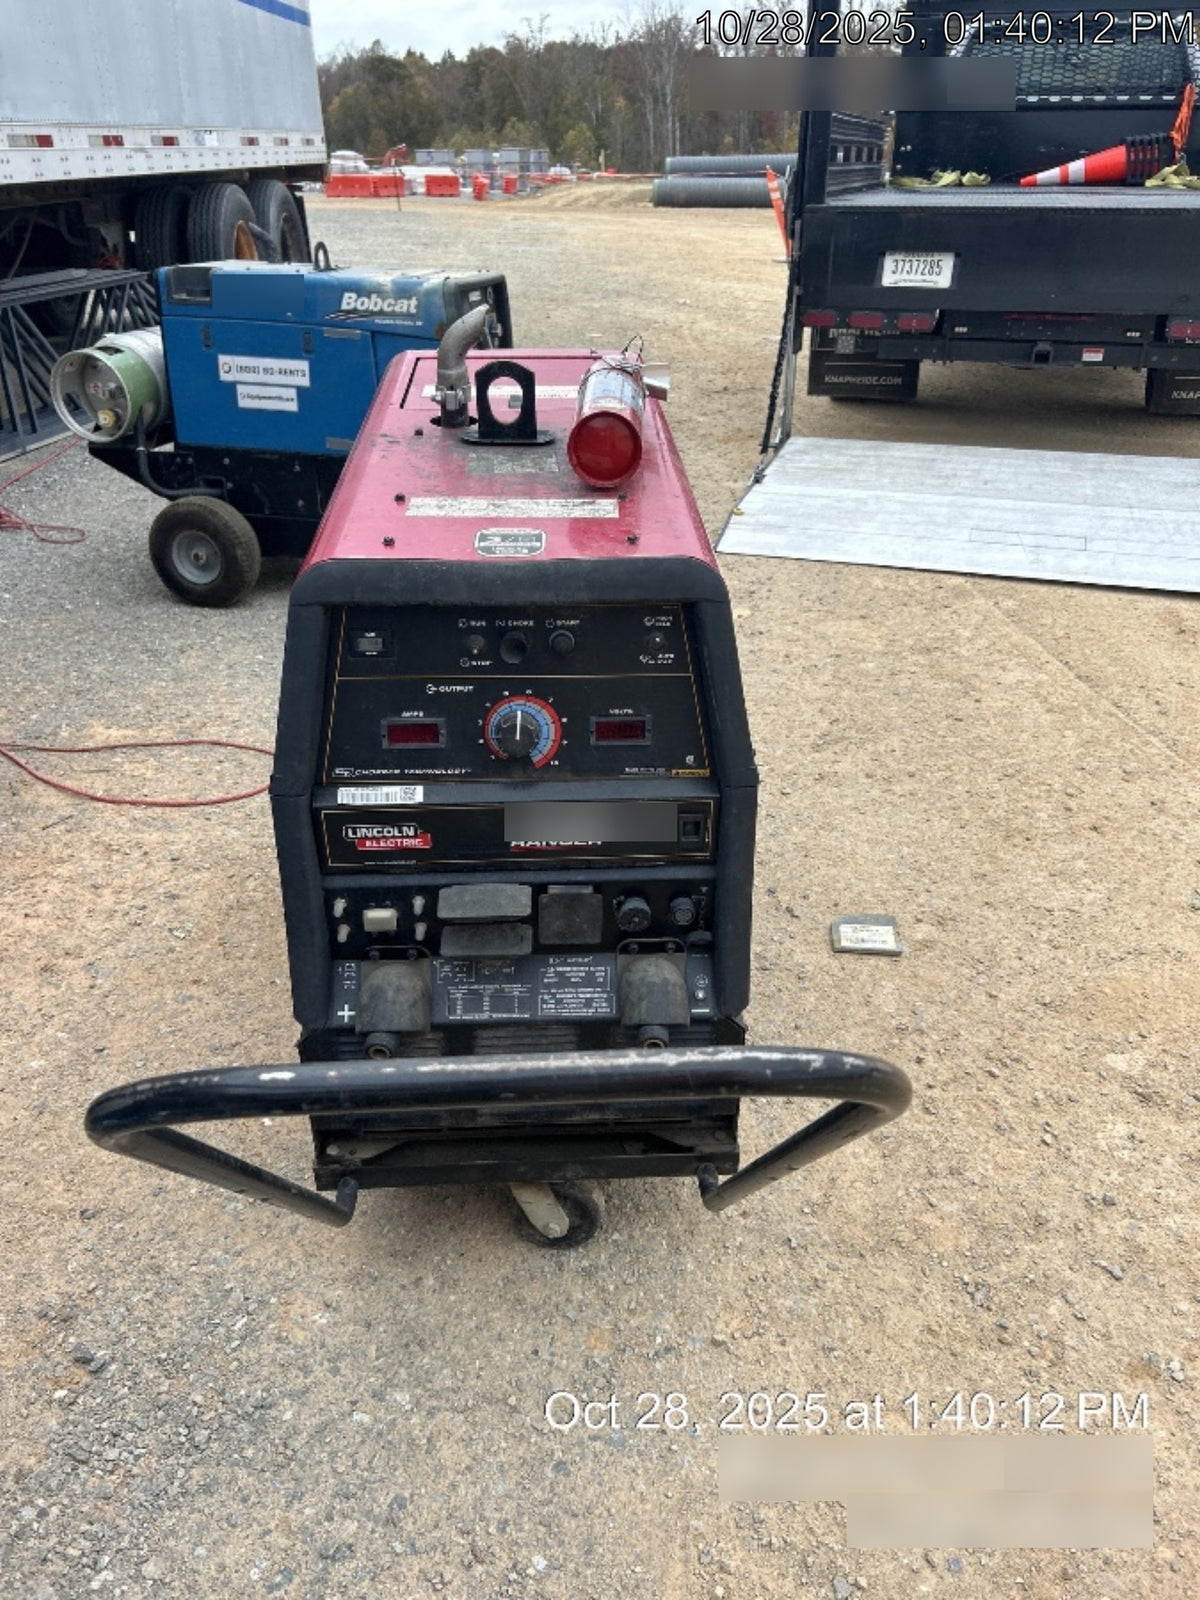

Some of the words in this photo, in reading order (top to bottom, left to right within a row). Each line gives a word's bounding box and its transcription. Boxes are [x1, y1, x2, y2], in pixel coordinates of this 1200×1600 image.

[891, 259, 944, 276] 3737285
[340, 292, 419, 314] Bobcat
[824, 374, 902, 385] KNAPHEIDE.COM
[438, 685, 474, 693] OUTPUT
[347, 826, 415, 838] LINCOLN
[364, 838, 424, 848] ELECTRIC
